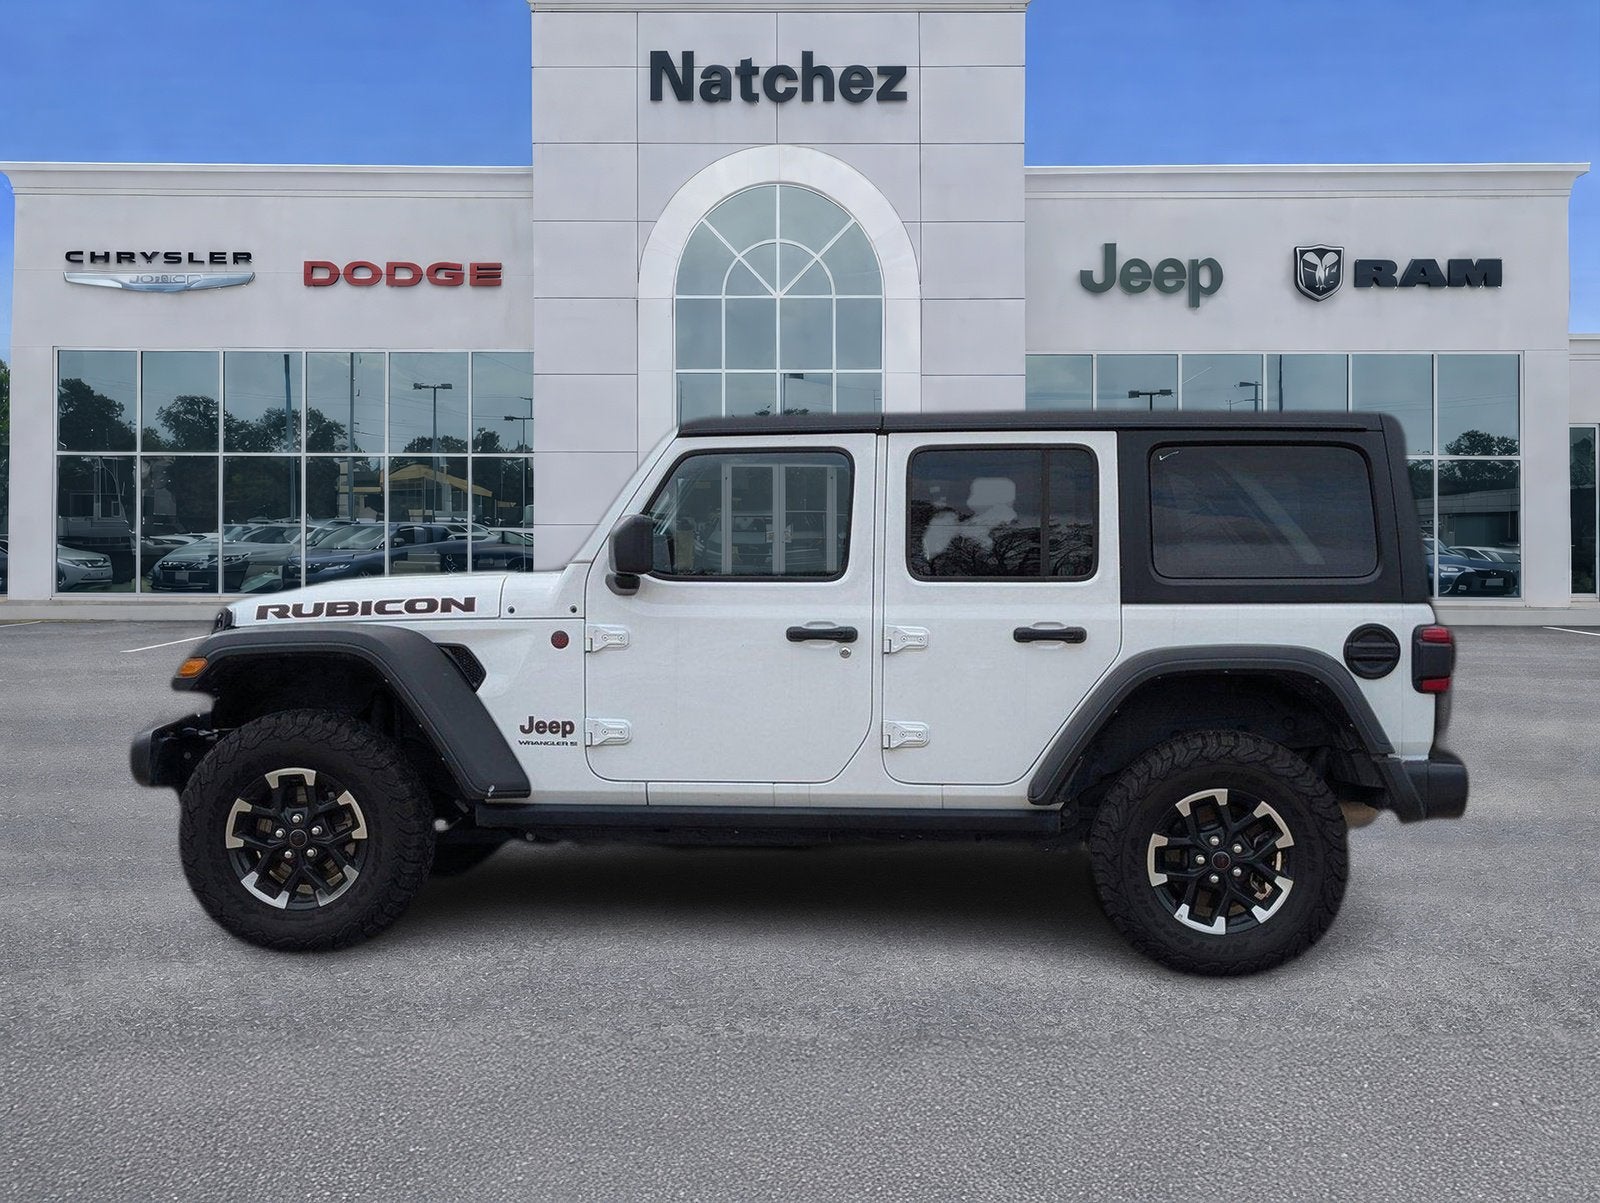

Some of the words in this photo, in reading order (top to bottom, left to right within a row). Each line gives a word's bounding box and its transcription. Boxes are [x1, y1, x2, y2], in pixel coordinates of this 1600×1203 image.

[650, 50, 908, 104] Natchez
[65, 250, 253, 265] CHRYSLER
[303, 260, 503, 287] DODGE
[1079, 242, 1224, 310] Jeep
[1353, 258, 1503, 288] RAM
[255, 597, 476, 620] RUBICON
[519, 715, 575, 738] Jeep
[517, 739, 569, 747] WRANGLER
